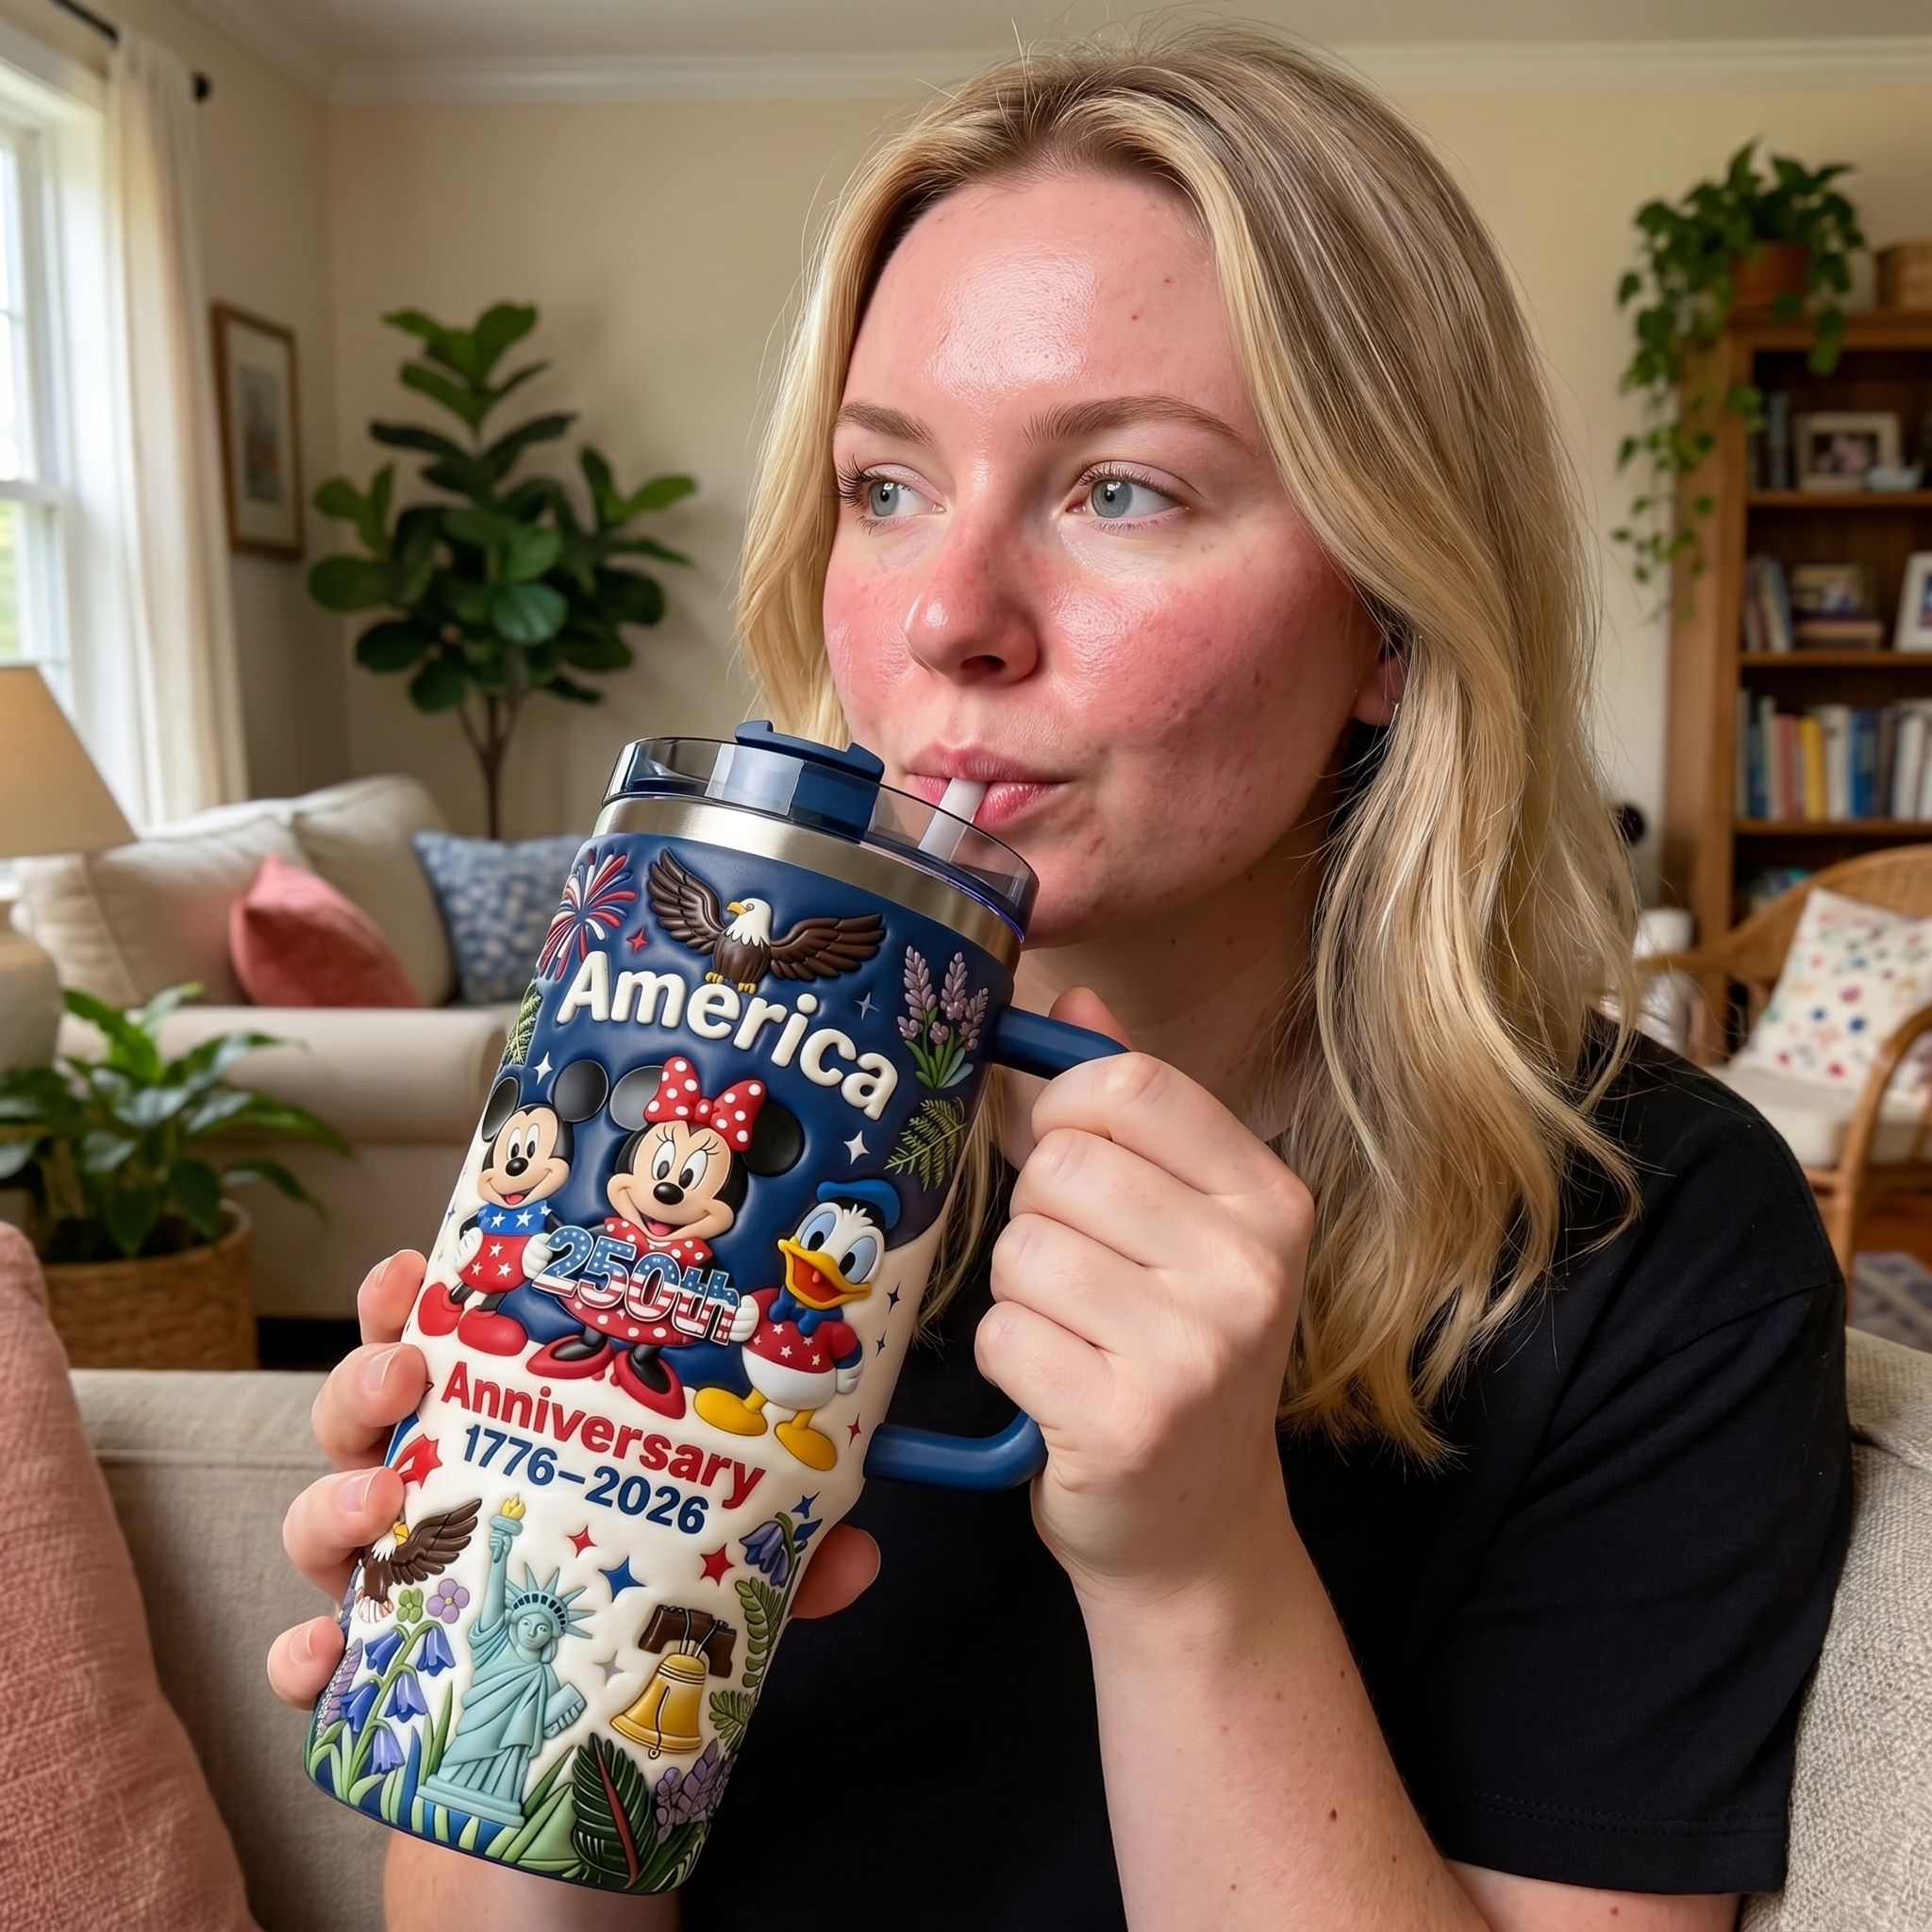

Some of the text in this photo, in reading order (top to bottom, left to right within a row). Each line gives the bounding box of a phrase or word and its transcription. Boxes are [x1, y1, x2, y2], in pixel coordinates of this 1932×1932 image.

[557, 951, 898, 1121] America
[532, 1225, 740, 1345] 250th
[441, 1361, 766, 1510] Anniversary
